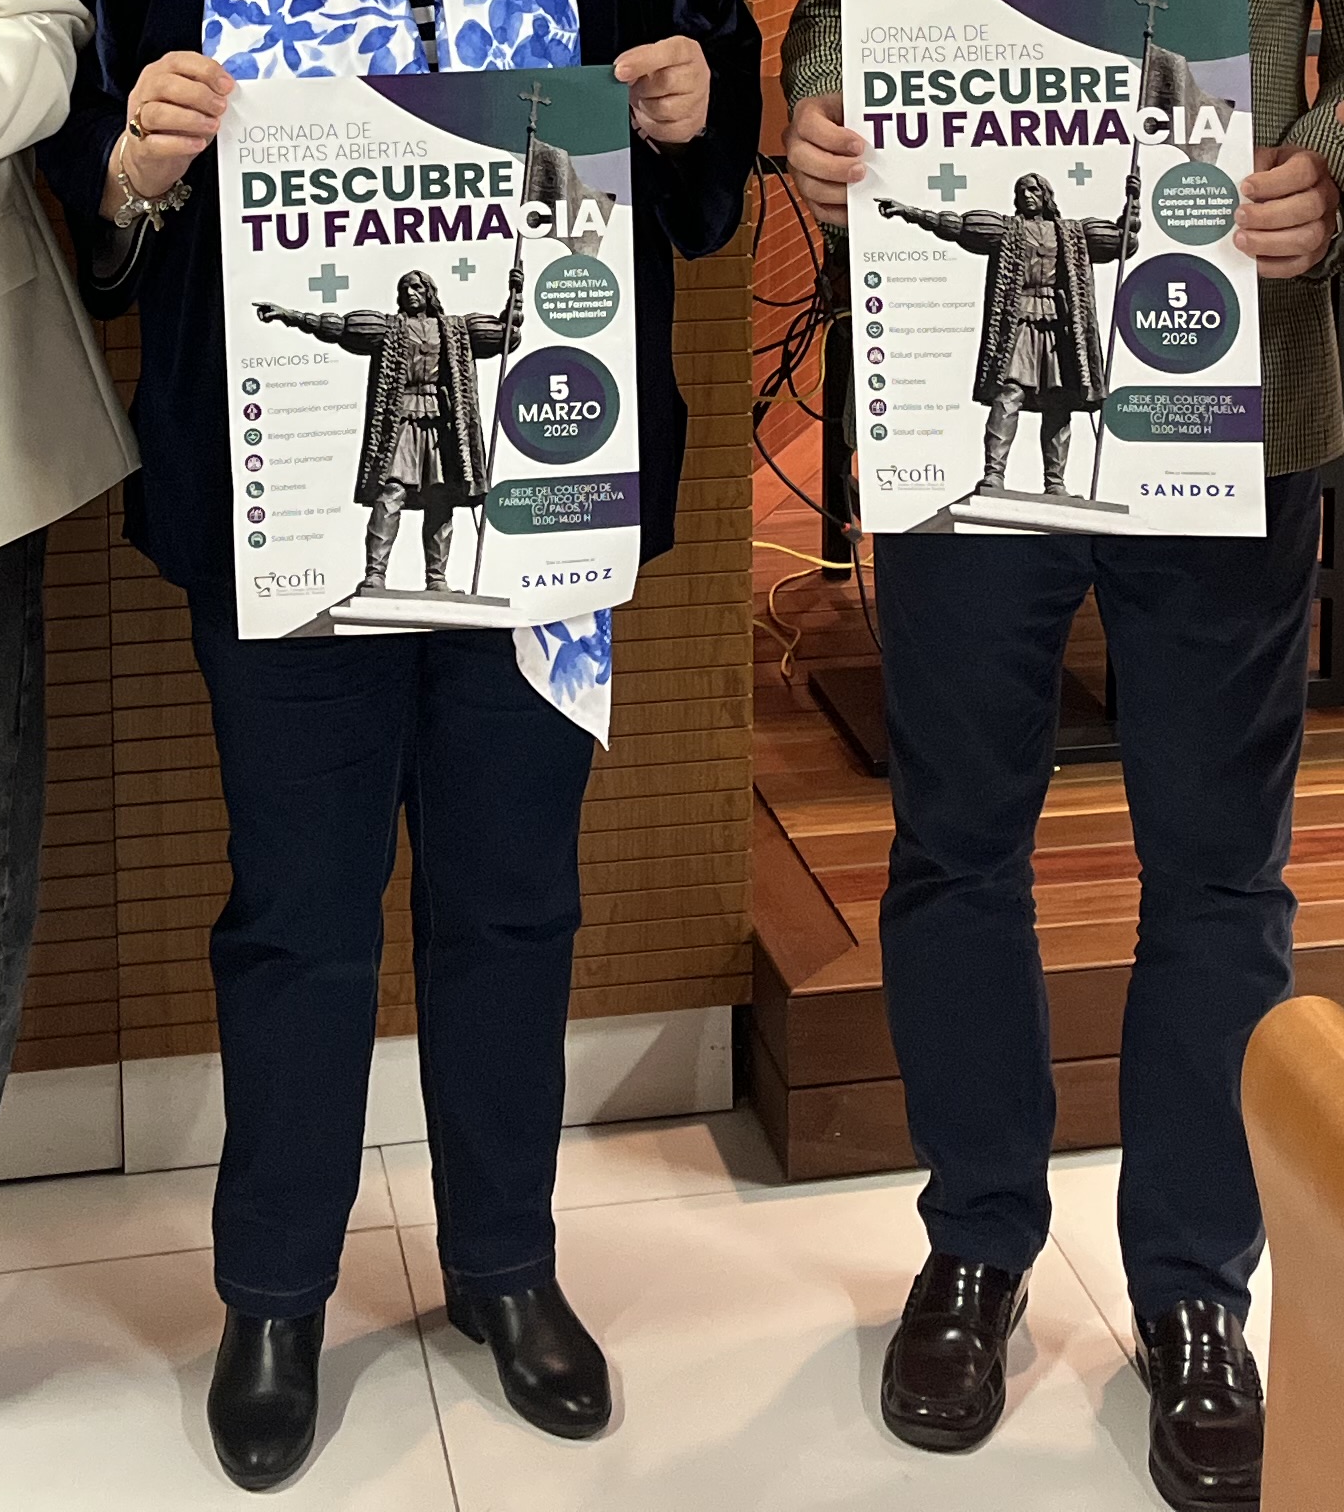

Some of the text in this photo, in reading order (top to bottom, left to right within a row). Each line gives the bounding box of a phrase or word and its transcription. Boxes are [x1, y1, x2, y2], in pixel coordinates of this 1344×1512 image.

[861, 24, 989, 44] JORNADA DE
[861, 43, 1044, 64] PUERTAS ABIERTAS
[863, 65, 1130, 107] DESCUBRE
[238, 122, 372, 144] JORNADA DE
[863, 106, 1226, 149] TU FARMACIA
[239, 140, 428, 164] PUERTAS ABIERTAS
[242, 161, 514, 209] DESCUBRE
[1182, 176, 1208, 185] MESA
[1164, 187, 1228, 196] INFORMATIVA
[1158, 197, 1233, 206] Conoce la labor
[1160, 208, 1231, 216] de la Farmacia
[242, 199, 608, 252] TU FARMACIA
[1168, 218, 1226, 228] Hospitalaria
[863, 251, 928, 262] SERVICIOS
[563, 269, 589, 278] MESA
[546, 280, 608, 289] INFORMATIVA
[540, 289, 614, 300] Conoce la labor
[1167, 282, 1188, 308] 5
[542, 299, 613, 309] de la Farmacia
[549, 310, 606, 321] Hospitalaria
[1136, 310, 1220, 329] MARZO
[1162, 332, 1198, 345] 2026
[241, 354, 309, 369] SERVICIOS
[549, 374, 570, 401] 5
[1129, 395, 1232, 404] SEDE DEL COLEGIO DE
[518, 400, 601, 423] MARZO
[1194, 404, 1206, 413] DE
[1208, 404, 1246, 414] HUELVA
[544, 423, 578, 437] 2026
[1204, 425, 1211, 434] H
[897, 464, 945, 482] cofh
[510, 483, 612, 497] SEDE DEL COLEGIO DE
[574, 493, 587, 503] DE
[589, 491, 624, 502] HUELVA
[1140, 483, 1235, 497] SANDOZ
[584, 513, 591, 522] H
[276, 568, 325, 588] cofh
[522, 568, 612, 588] SANDOZ
